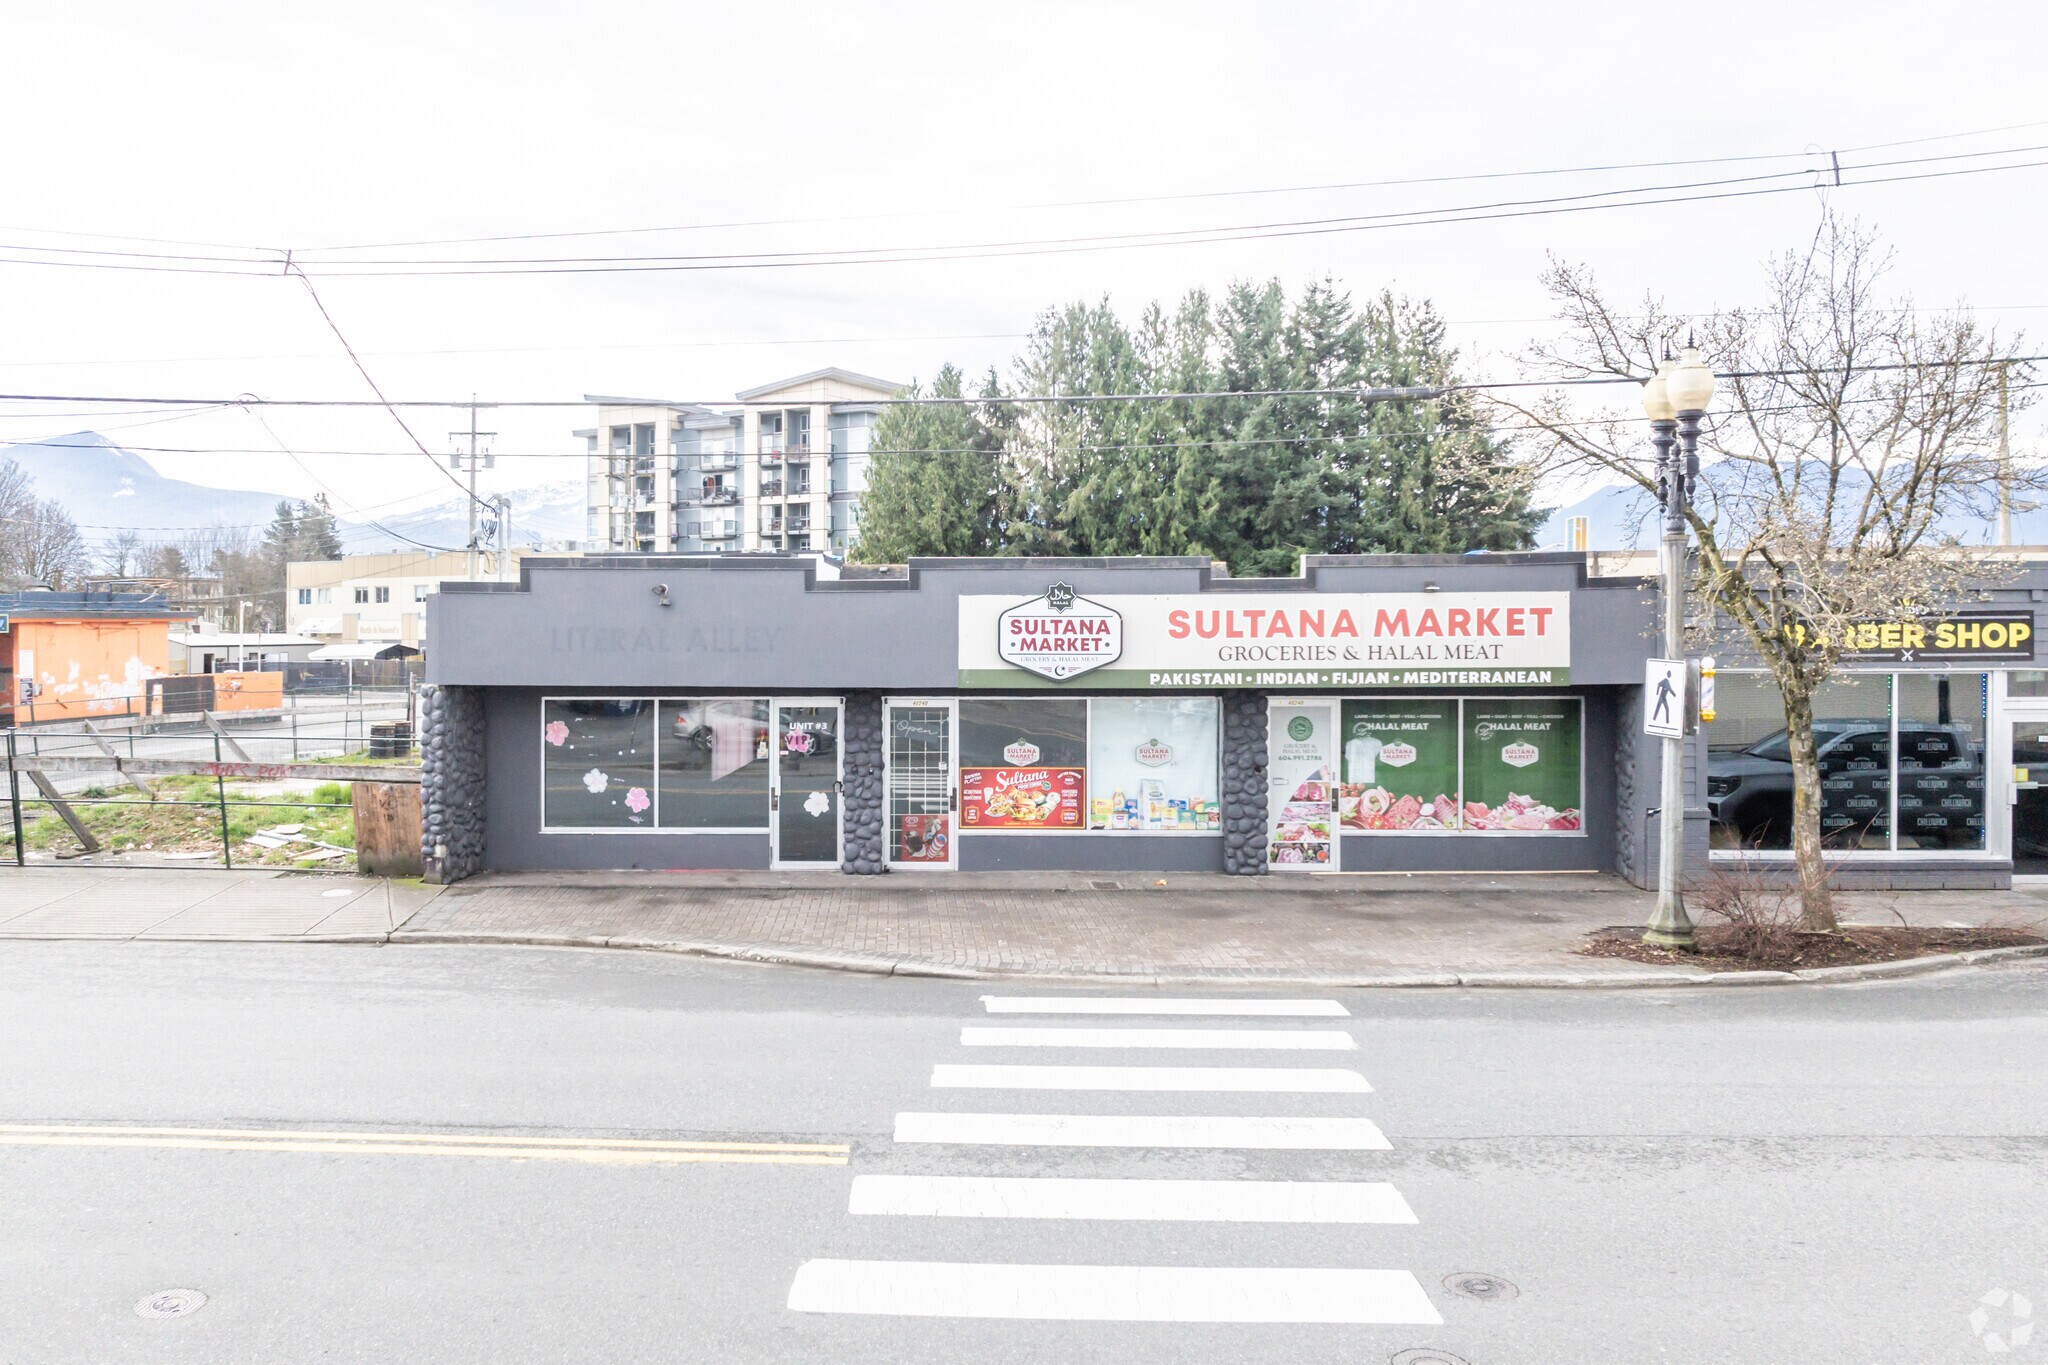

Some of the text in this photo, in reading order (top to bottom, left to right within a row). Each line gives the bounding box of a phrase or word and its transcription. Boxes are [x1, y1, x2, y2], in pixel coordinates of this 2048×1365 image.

[1010, 619, 1111, 635] SULTANA
[1168, 607, 1553, 639] SULTANA MARKET
[551, 627, 782, 652] LITERAL ALLEY
[1935, 622, 2031, 649] SHOP
[1020, 638, 1102, 651] MARKET
[1218, 644, 1503, 661] GROCERIES & HALAL MEAT
[1150, 671, 1552, 685] PAKISTANI INDIAN FIJIAN MEDITERRANEAN
[789, 722, 828, 730] UNIT #3
[897, 720, 938, 737] Open
[1367, 722, 1429, 730] HALAL MEAT
[1489, 722, 1552, 730] HALAL MEAT
[995, 770, 1049, 792] Sultana
